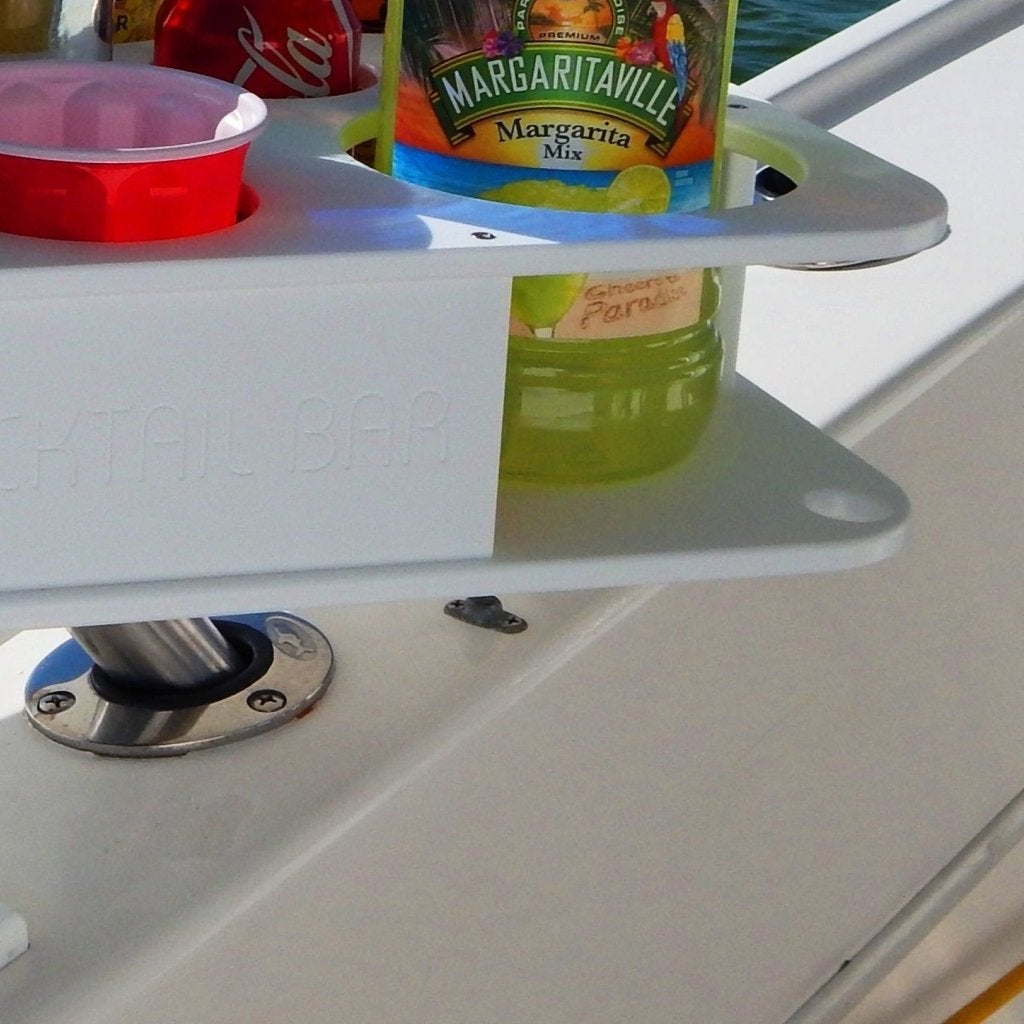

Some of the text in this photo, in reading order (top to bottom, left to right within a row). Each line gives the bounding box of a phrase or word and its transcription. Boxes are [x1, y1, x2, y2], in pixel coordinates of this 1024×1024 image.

[538, 31, 601, 42] PREMIUM
[441, 53, 680, 127] MARGARITAVILLE
[494, 115, 631, 149] Margarita
[542, 143, 583, 162] Mix
[289, 388, 450, 474] BAR
